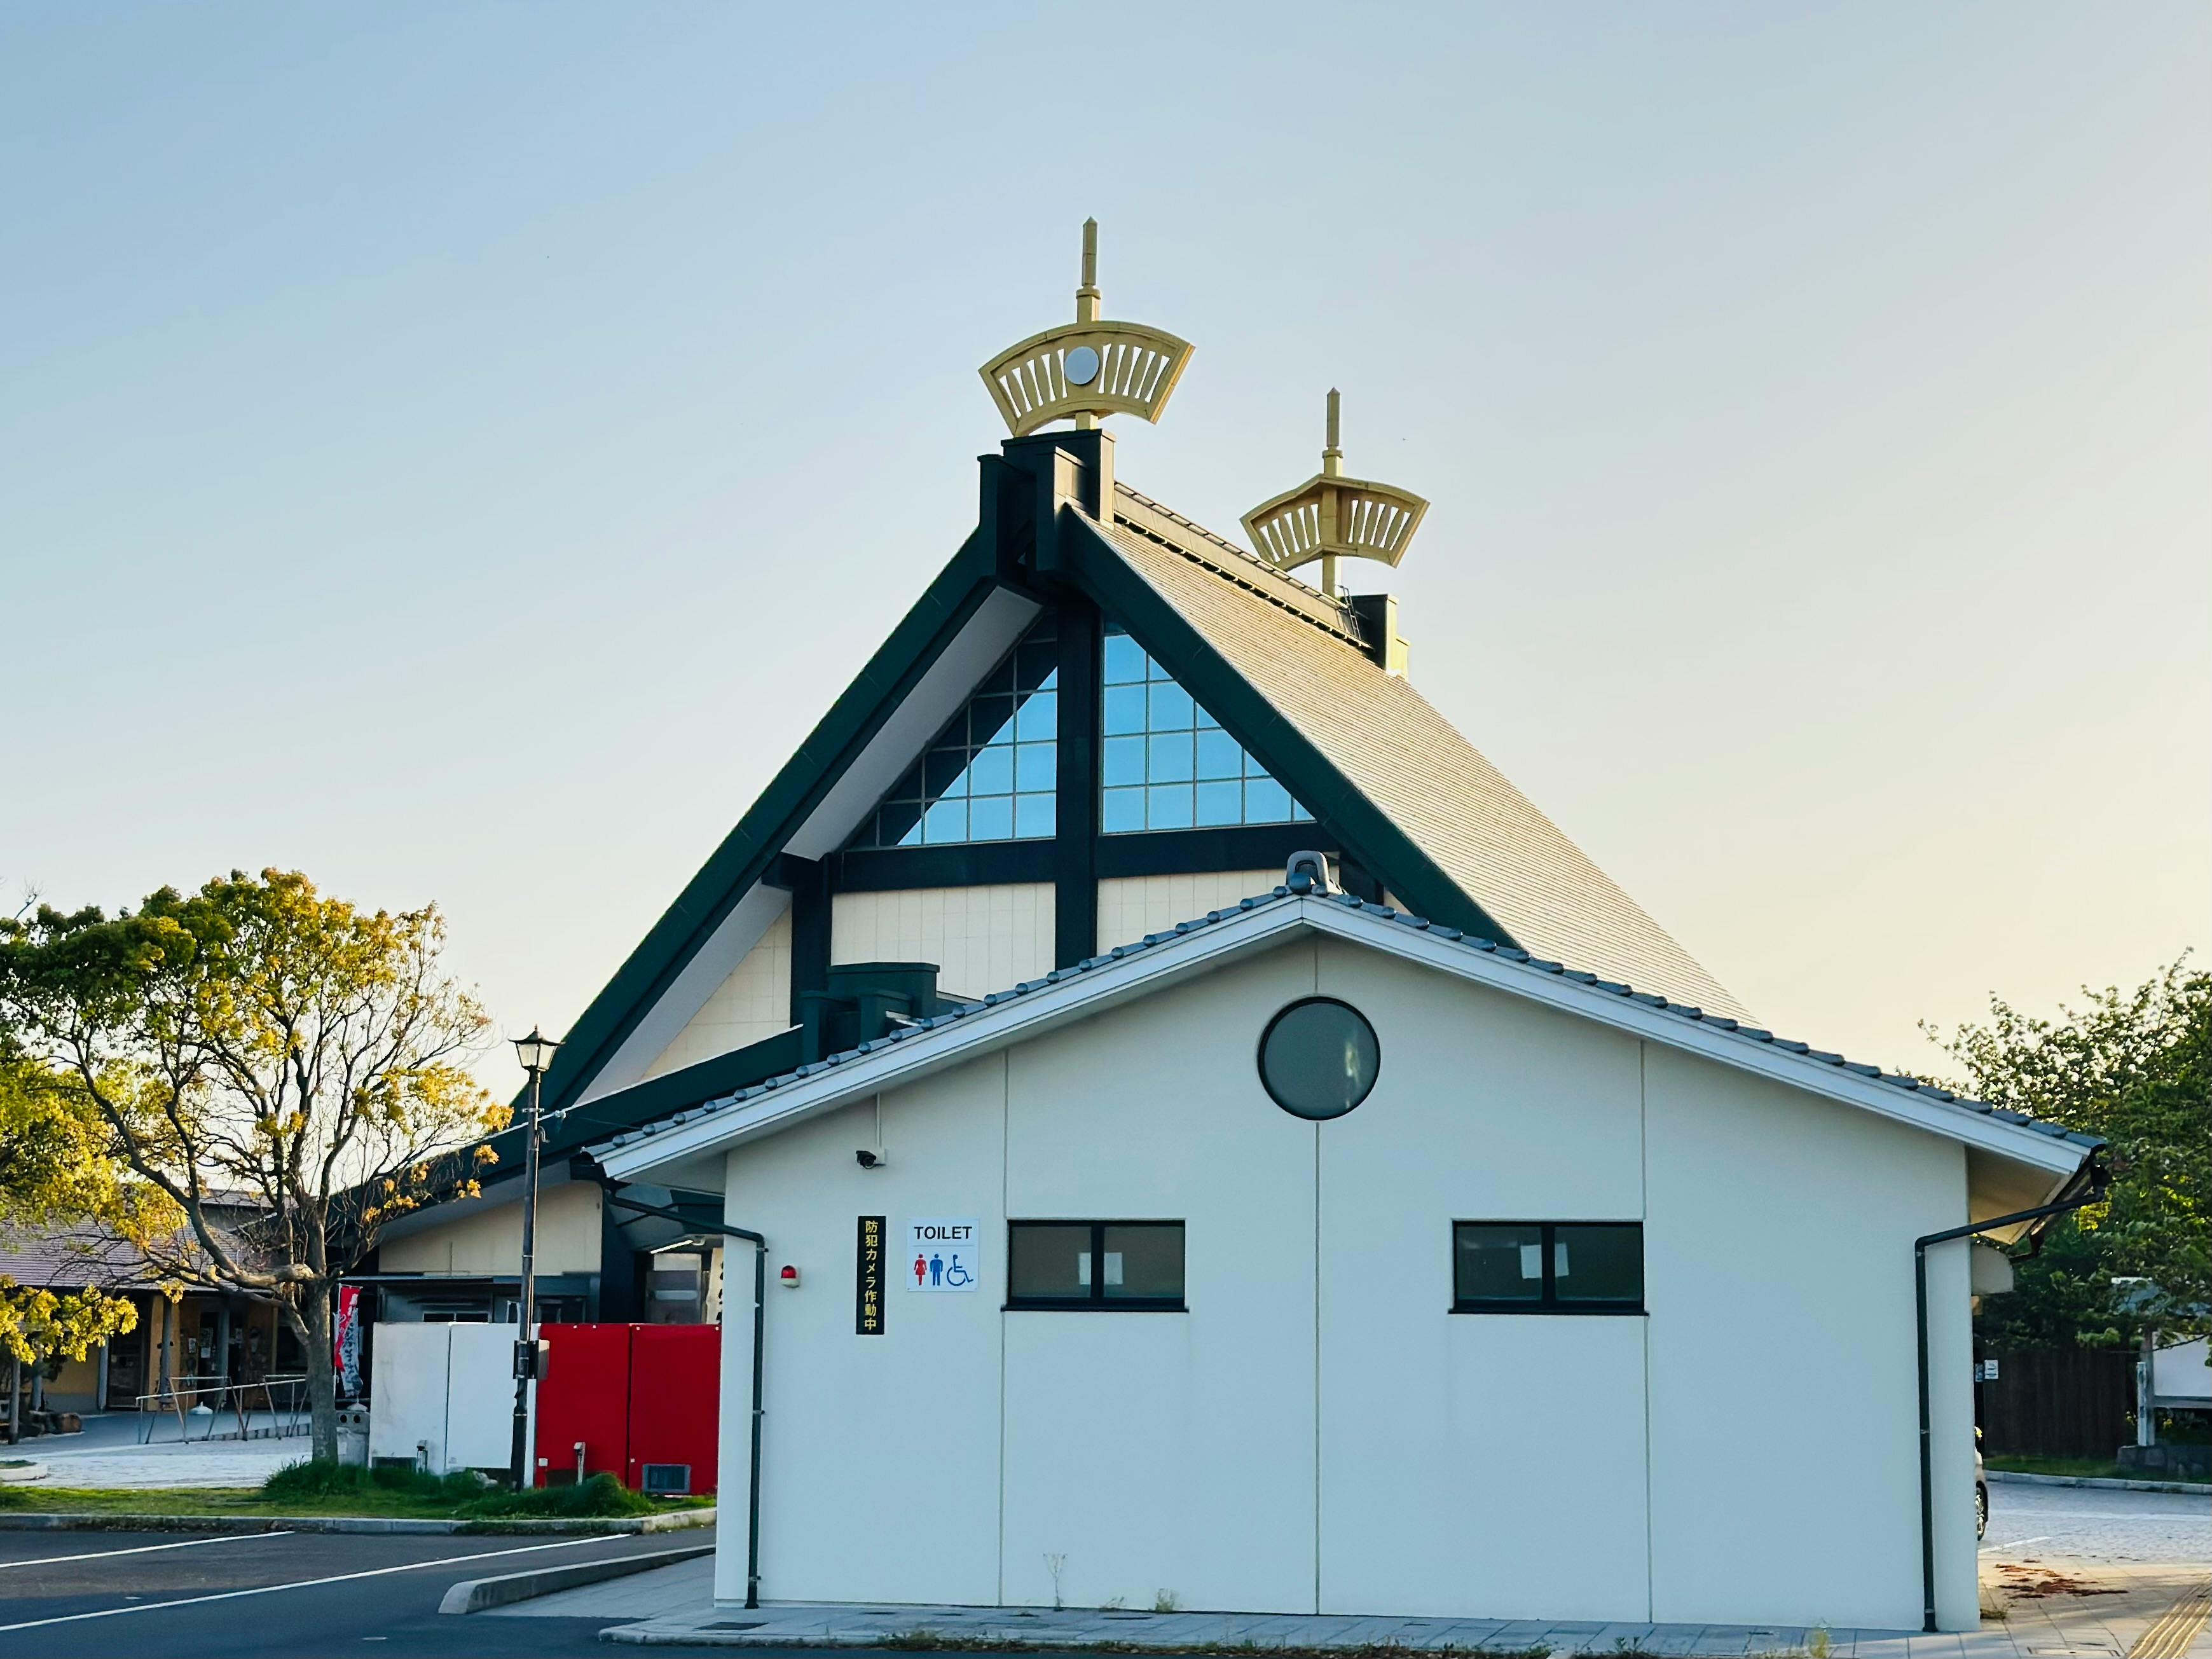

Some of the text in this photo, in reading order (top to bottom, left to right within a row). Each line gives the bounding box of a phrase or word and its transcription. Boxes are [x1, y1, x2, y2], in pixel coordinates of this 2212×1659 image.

[914, 1226, 973, 1239] TOILET
[864, 1220, 879, 1331] 防犯カメラ作動中
